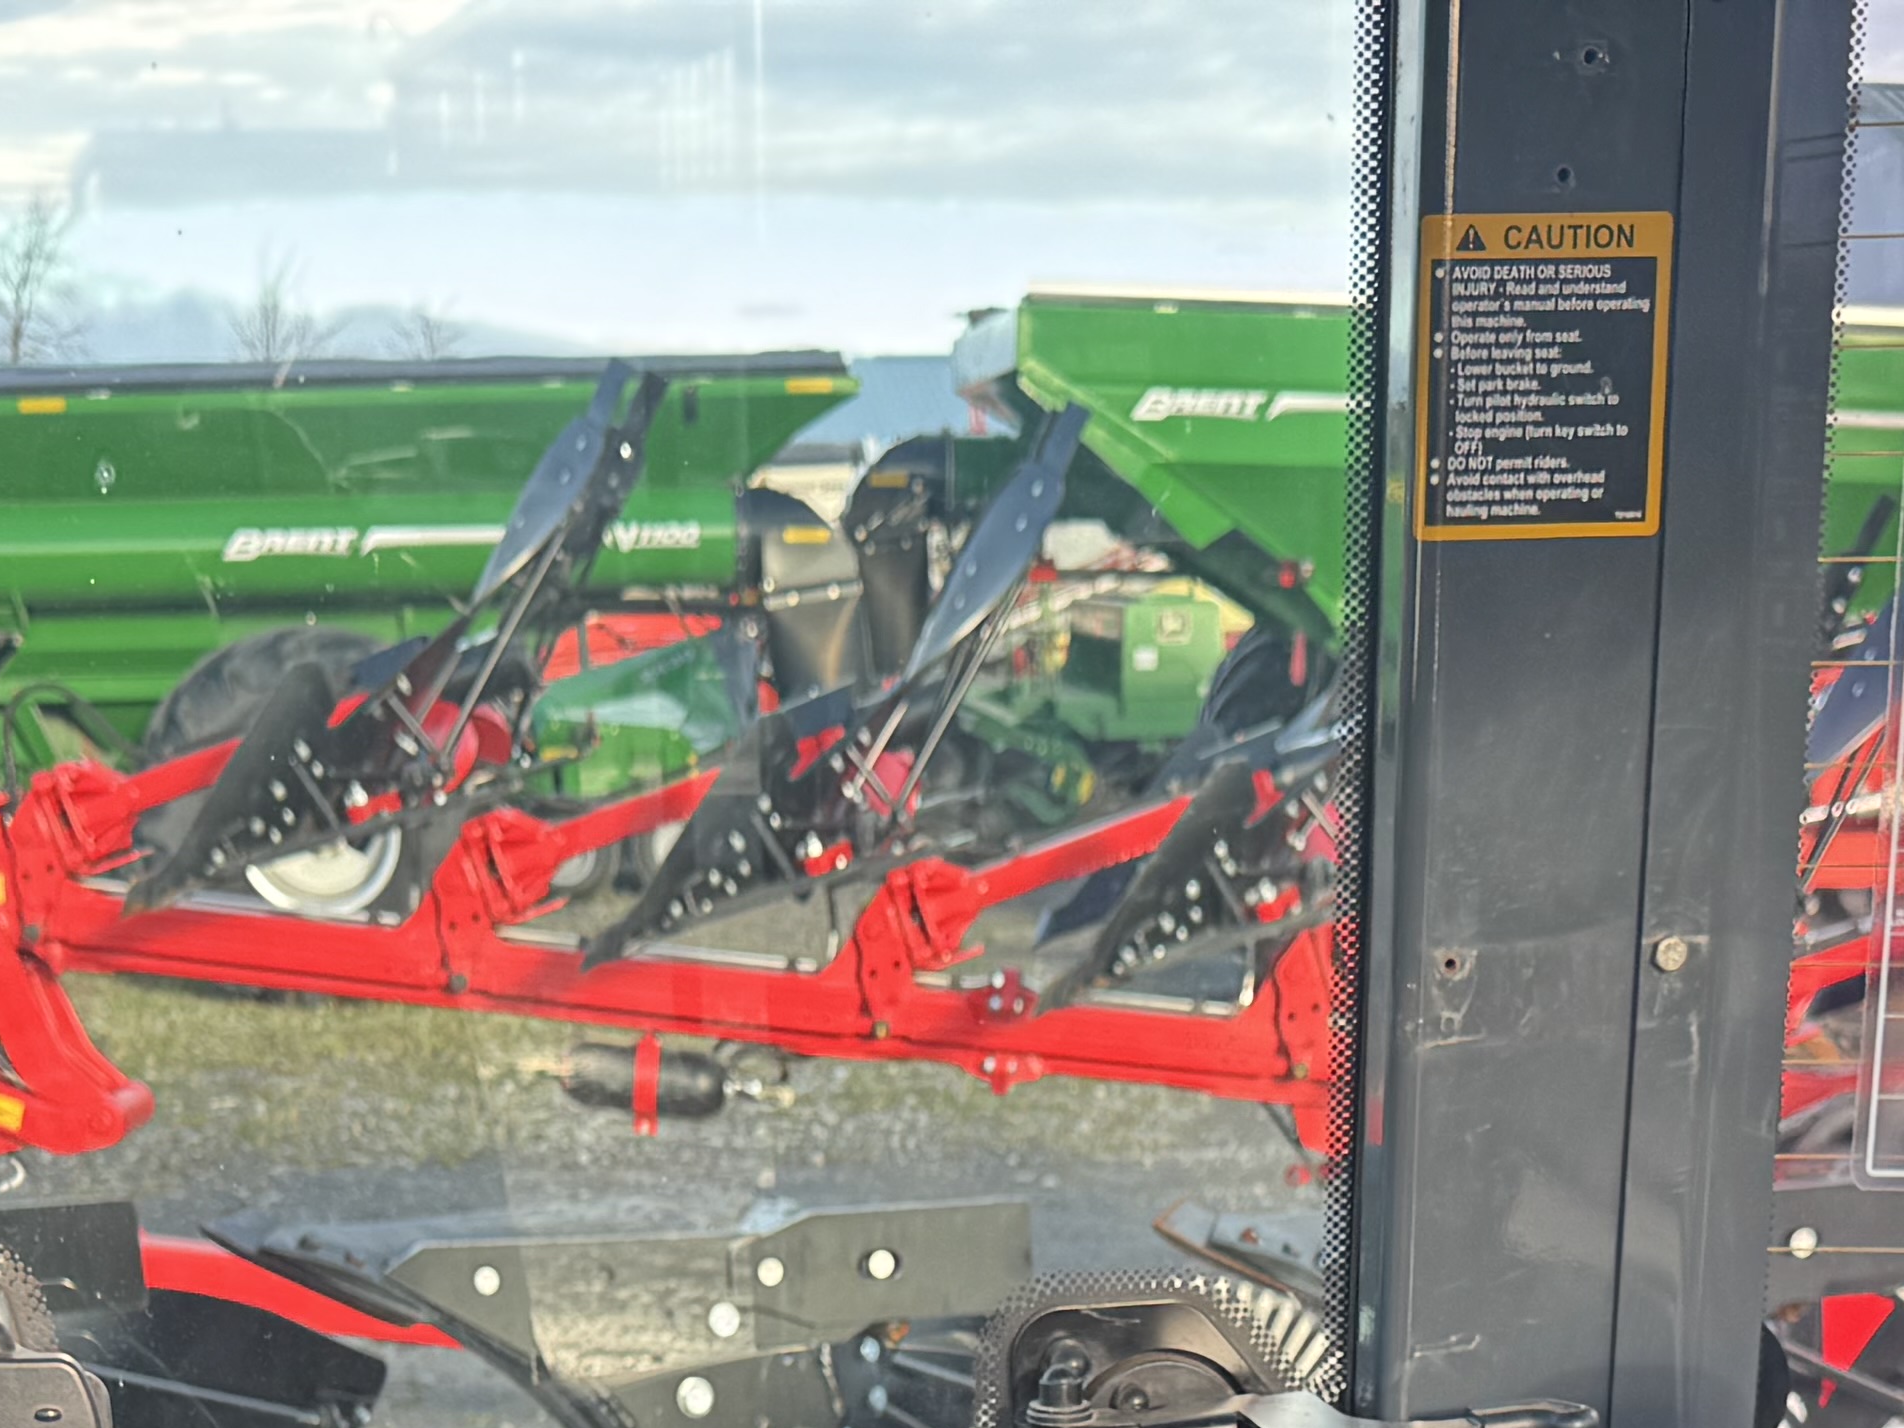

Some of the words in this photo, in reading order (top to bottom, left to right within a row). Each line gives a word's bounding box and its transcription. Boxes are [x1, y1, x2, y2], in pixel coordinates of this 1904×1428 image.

[1504, 224, 1635, 250] CAUTION
[1453, 266, 1492, 280] AVOID
[1494, 266, 1535, 279] DEATH
[1537, 265, 1556, 278] OR
[1559, 264, 1612, 278] SERIOUS
[1452, 282, 1496, 296] INJURY
[1506, 282, 1536, 295] Read
[1538, 282, 1560, 295] and
[1562, 280, 1627, 294] understand
[1451, 298, 1509, 314] operator's
[1514, 298, 1556, 312] manual
[1558, 298, 1594, 311] before
[1596, 296, 1651, 312] operating
[1452, 316, 1473, 328] this
[1475, 314, 1527, 328] machine.
[1450, 331, 1496, 346] Operate
[1498, 330, 1524, 346] only
[1526, 330, 1553, 342] from
[1556, 330, 1583, 342] seat.
[1450, 348, 1488, 361] Before
[1491, 347, 1532, 362] leaving
[1534, 346, 1562, 360] seat:
[1457, 363, 1493, 376] Lower
[1494, 362, 1534, 376] bucket
[1536, 362, 1548, 374] to
[1550, 361, 1594, 378] ground.
[1456, 378, 1476, 392] Set
[1478, 378, 1504, 394] park
[1506, 378, 1541, 390] brake.
[1456, 394, 1484, 407] Turn
[1485, 394, 1512, 408] pilot
[1514, 394, 1566, 410] hydraulic
[1568, 393, 1605, 406] switch
[1607, 393, 1620, 406] to
[1455, 410, 1494, 424] locked
[1496, 410, 1545, 425] position.
[1455, 426, 1483, 440] Stop
[1484, 426, 1523, 441] engine
[1524, 425, 1553, 441] (turn
[1554, 424, 1576, 440] key
[1577, 424, 1614, 437] switch
[1616, 424, 1629, 436] to
[1454, 442, 1484, 455] OFF)
[1447, 458, 1466, 471] DO
[1468, 457, 1493, 470] NOT
[1496, 456, 1532, 472] permit
[1534, 456, 1570, 470] riders.
[1446, 472, 1480, 486] Avoid
[1482, 472, 1525, 486] contact
[1526, 471, 1551, 484] with
[1552, 470, 1606, 484] overhead
[1446, 488, 1500, 502] obstacles
[1502, 488, 1534, 500] when
[1535, 486, 1589, 502] operating
[1590, 488, 1604, 498] or
[1446, 504, 1488, 520] hauling
[1490, 504, 1541, 516] machine.
